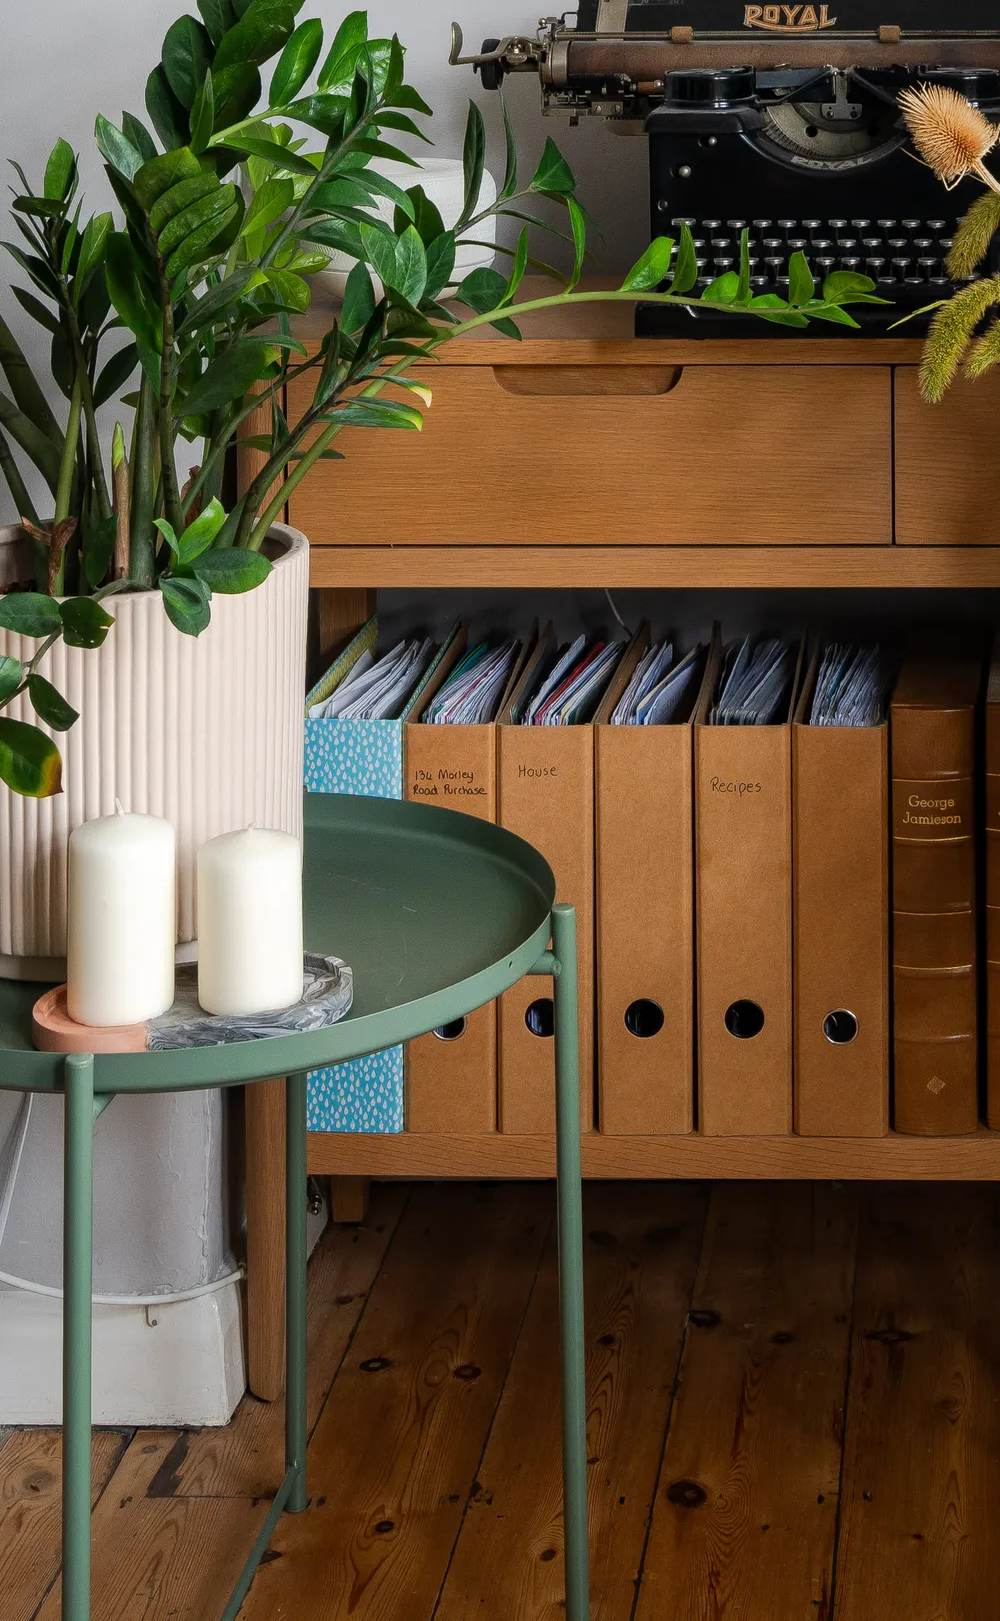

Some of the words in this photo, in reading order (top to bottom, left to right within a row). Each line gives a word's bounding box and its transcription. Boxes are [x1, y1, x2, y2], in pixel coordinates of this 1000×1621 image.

[743, 4, 838, 33] ROYAL
[790, 155, 873, 171] ROYAL
[438, 769, 474, 783] Morley
[518, 764, 558, 778] House
[413, 784, 439, 796] Road
[444, 784, 488, 796] Purchase
[710, 776, 762, 797] Recipes
[908, 794, 955, 811] George
[902, 811, 962, 825] Jamieson
